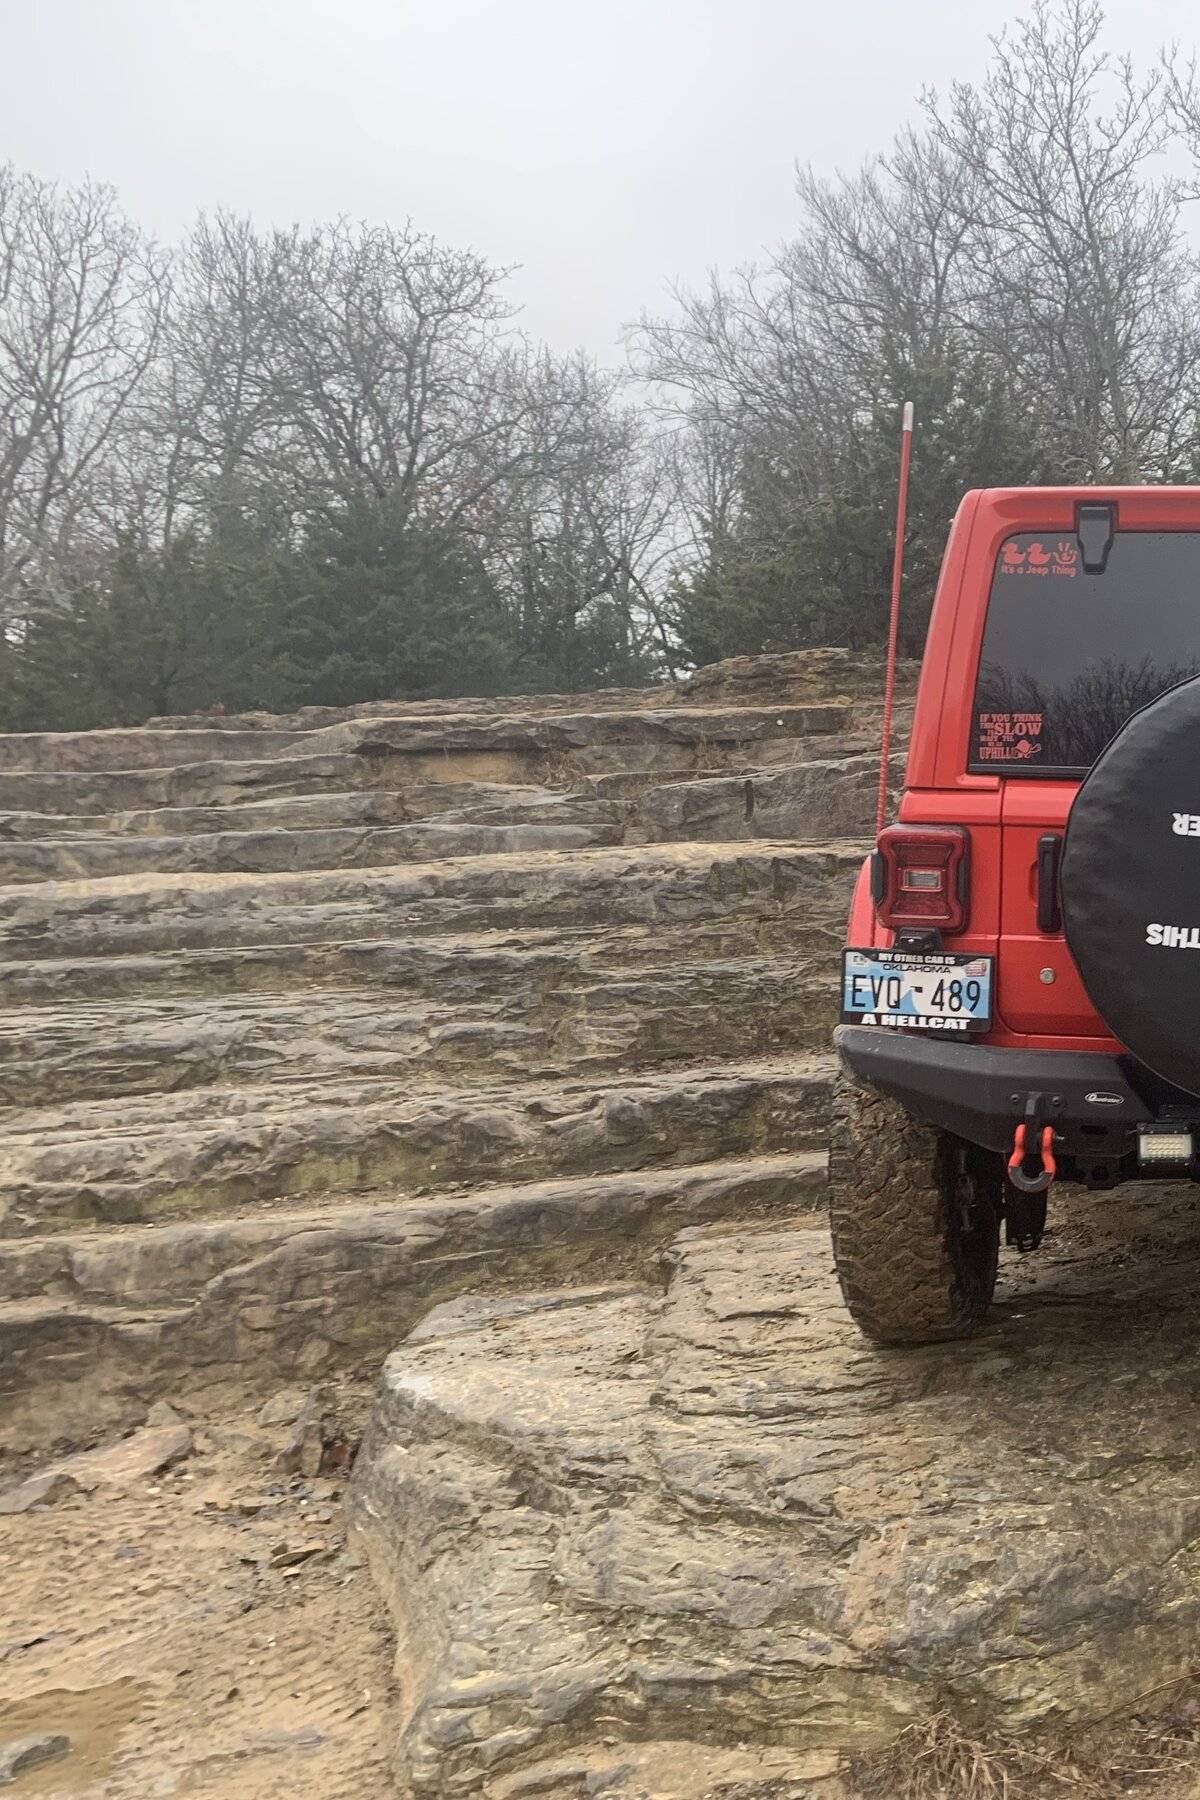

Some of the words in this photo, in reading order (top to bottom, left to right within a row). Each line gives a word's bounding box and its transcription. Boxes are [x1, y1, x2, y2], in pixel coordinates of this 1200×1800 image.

[1002, 565, 1015, 574] It's
[1026, 566, 1049, 576] Jeep
[1052, 566, 1076, 577] Thing
[980, 714, 990, 722] IF
[991, 714, 1010, 722] YOU
[1012, 714, 1042, 722] THINK
[994, 722, 1041, 736] SLOW
[878, 952, 892, 962] MY
[894, 954, 924, 964] OTHER
[924, 955, 943, 964] CAR
[945, 956, 956, 965] IS
[883, 963, 951, 974] OKLAHOMA
[851, 974, 901, 1009] EVQ
[931, 979, 981, 1013] 489
[860, 1013, 877, 1025] A
[881, 1014, 971, 1030] HELLCAT
